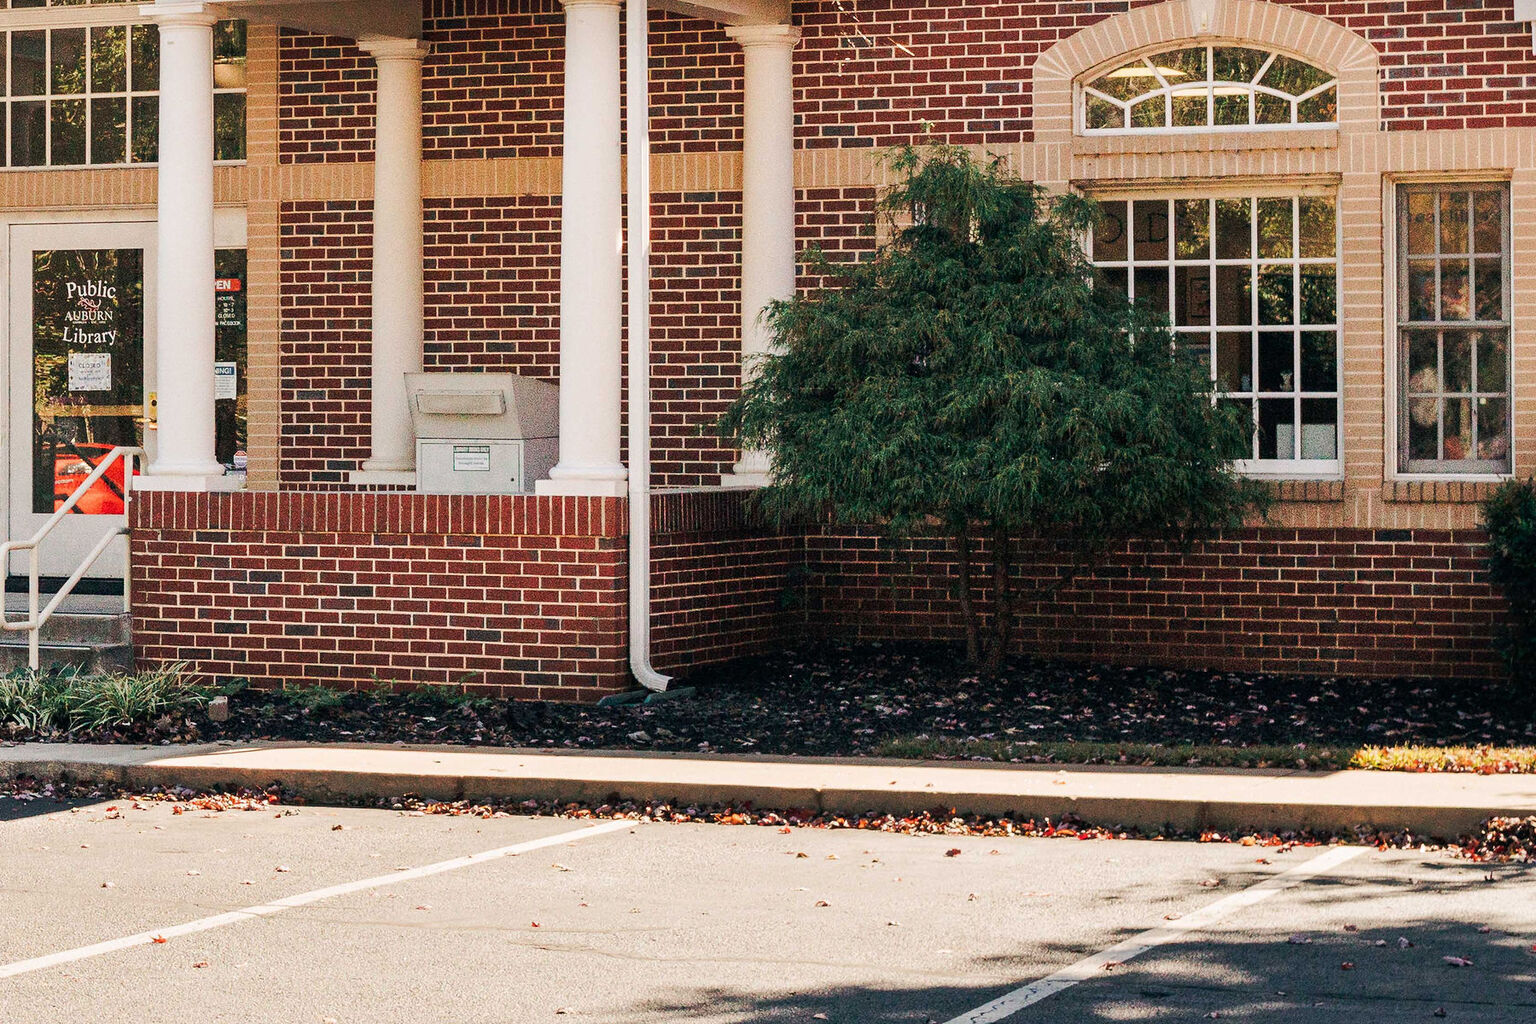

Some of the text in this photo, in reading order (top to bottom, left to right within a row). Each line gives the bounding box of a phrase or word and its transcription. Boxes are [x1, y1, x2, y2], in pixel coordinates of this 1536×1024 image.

[66, 280, 117, 299] Public
[215, 280, 231, 290] EN
[64, 311, 113, 321] AUBURN
[62, 326, 117, 346] Library
